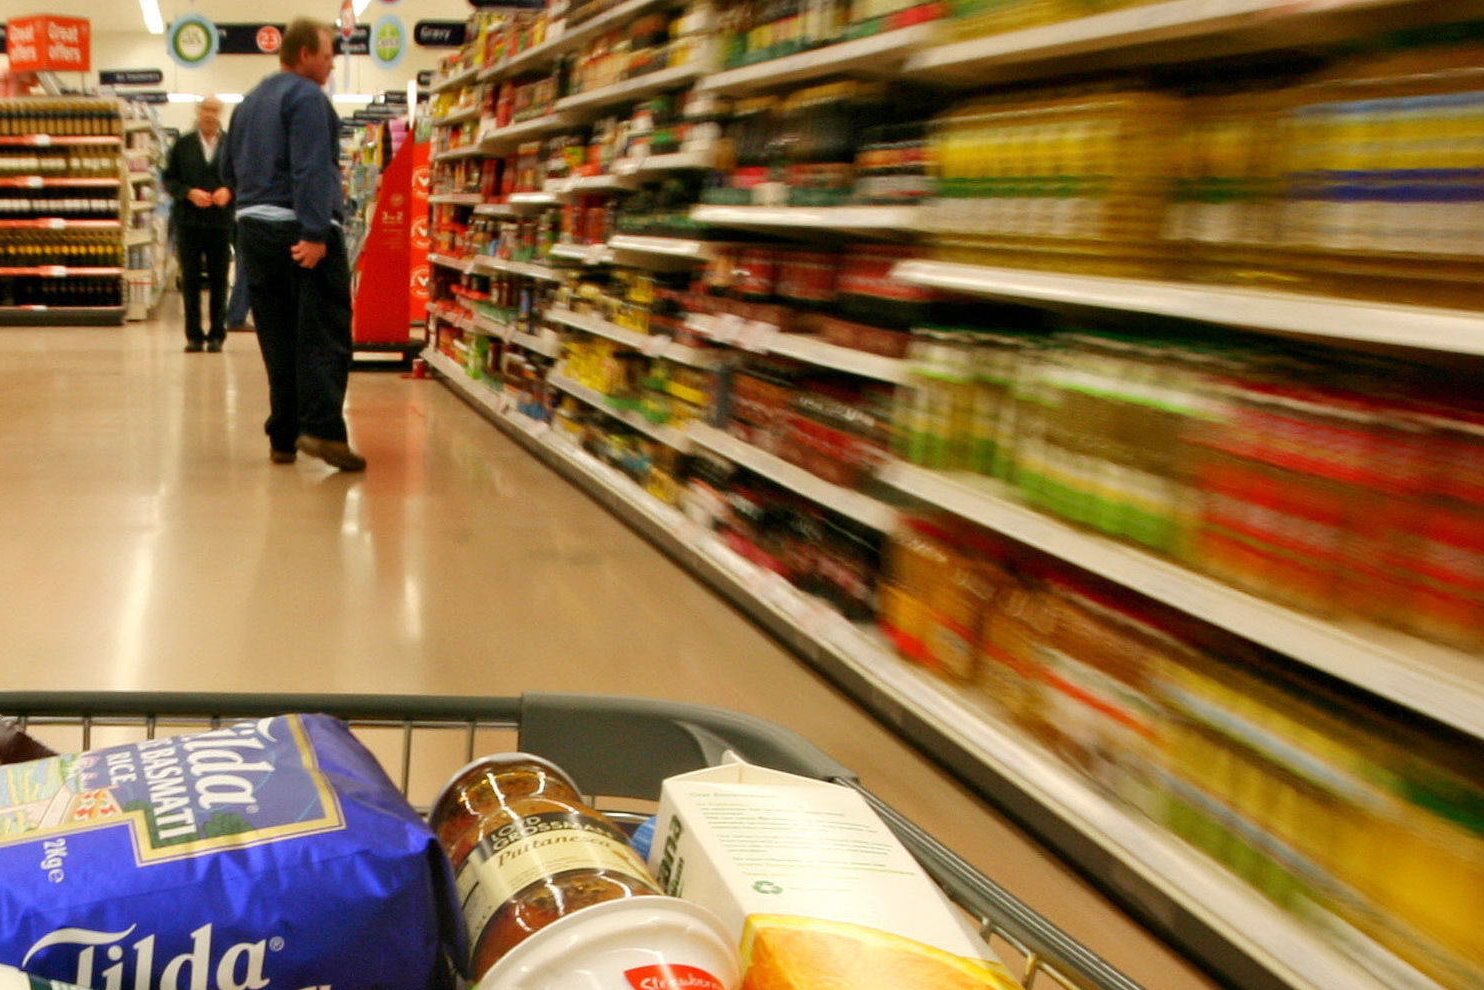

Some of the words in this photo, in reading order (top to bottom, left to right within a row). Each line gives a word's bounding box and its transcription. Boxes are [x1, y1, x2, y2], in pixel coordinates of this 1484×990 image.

[420, 26, 451, 42] Gravy
[105, 751, 137, 784] RICE
[140, 748, 198, 841] BASMATI
